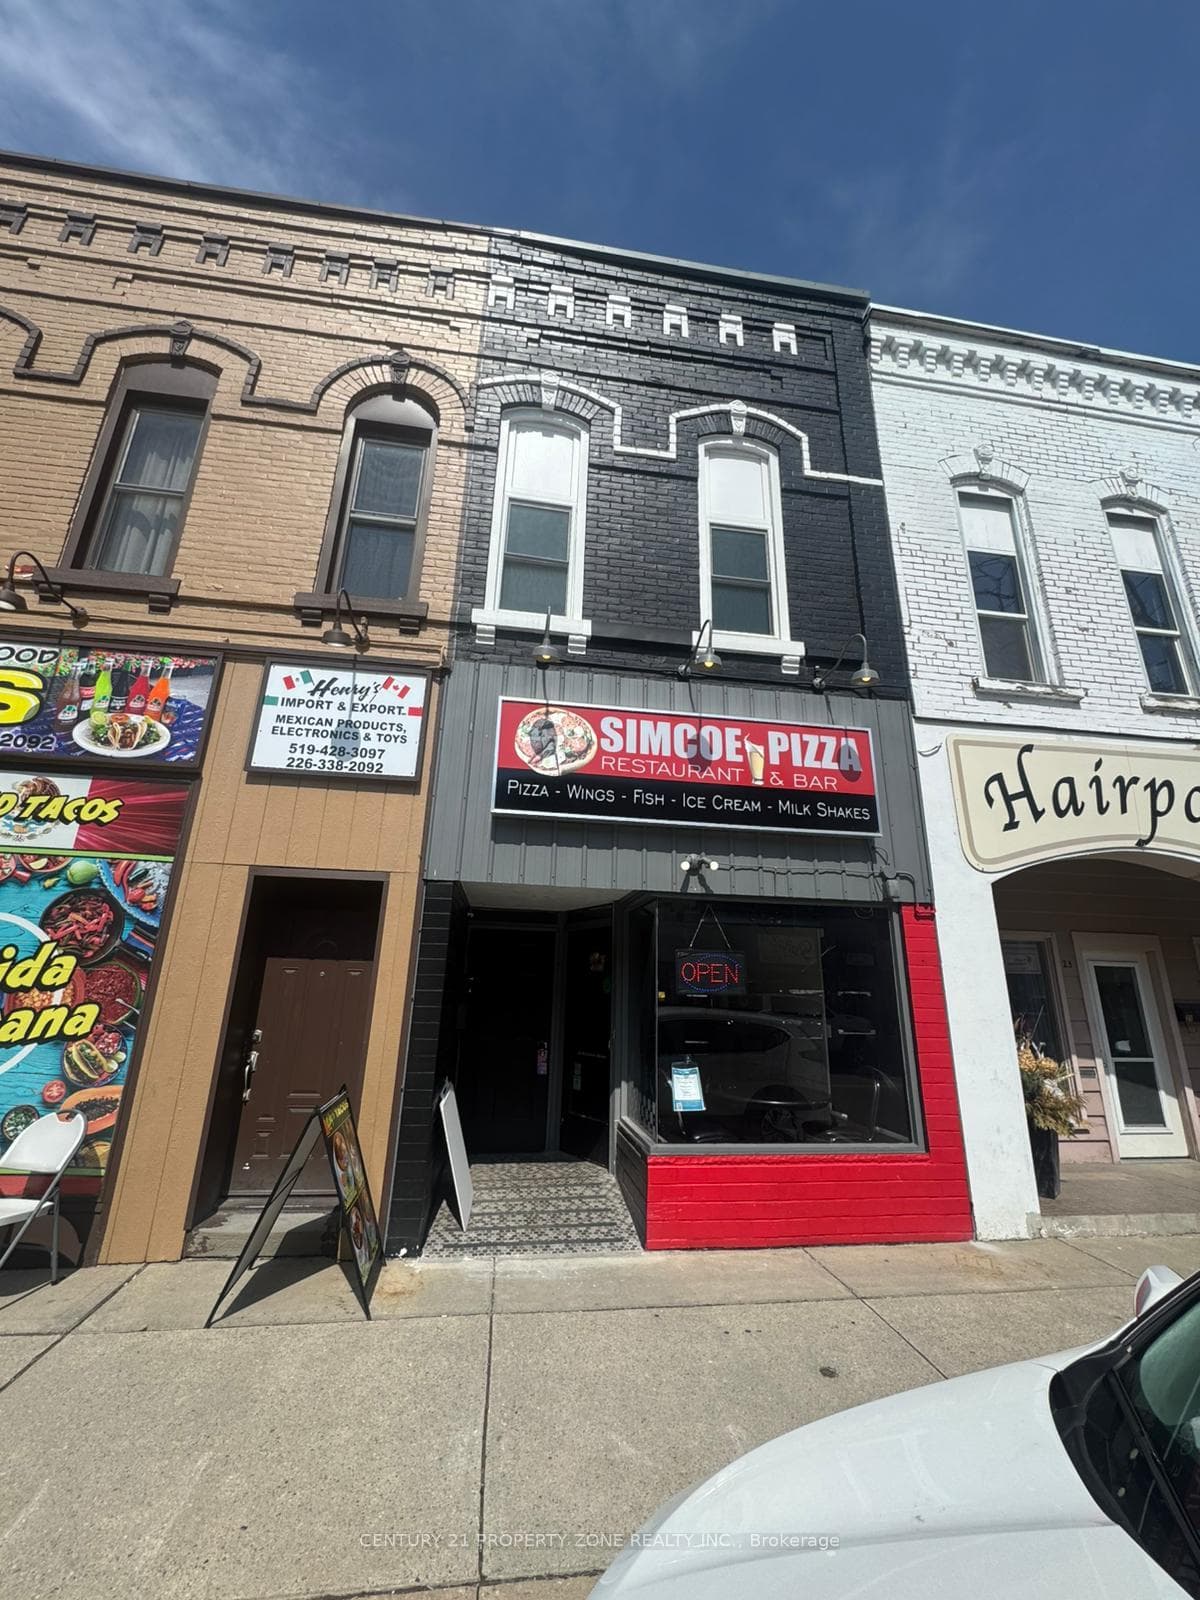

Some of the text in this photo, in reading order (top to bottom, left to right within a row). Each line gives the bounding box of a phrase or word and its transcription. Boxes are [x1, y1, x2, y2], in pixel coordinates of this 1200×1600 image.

[308, 677, 382, 702] Henry's
[281, 697, 333, 711] IMPORT
[337, 702, 346, 711] &
[275, 715, 407, 734] MEXICAN PRODUCTS,
[271, 726, 408, 744] ELECTRONICS & TOYS
[600, 716, 863, 772] SIMCOE PIZZA
[289, 743, 386, 759] 519-428-3097
[286, 757, 384, 773] 226-338-2092
[601, 756, 838, 791] RESTAURANT & BAR
[17, 795, 124, 825] TACOS
[681, 962, 739, 983] OPEN
